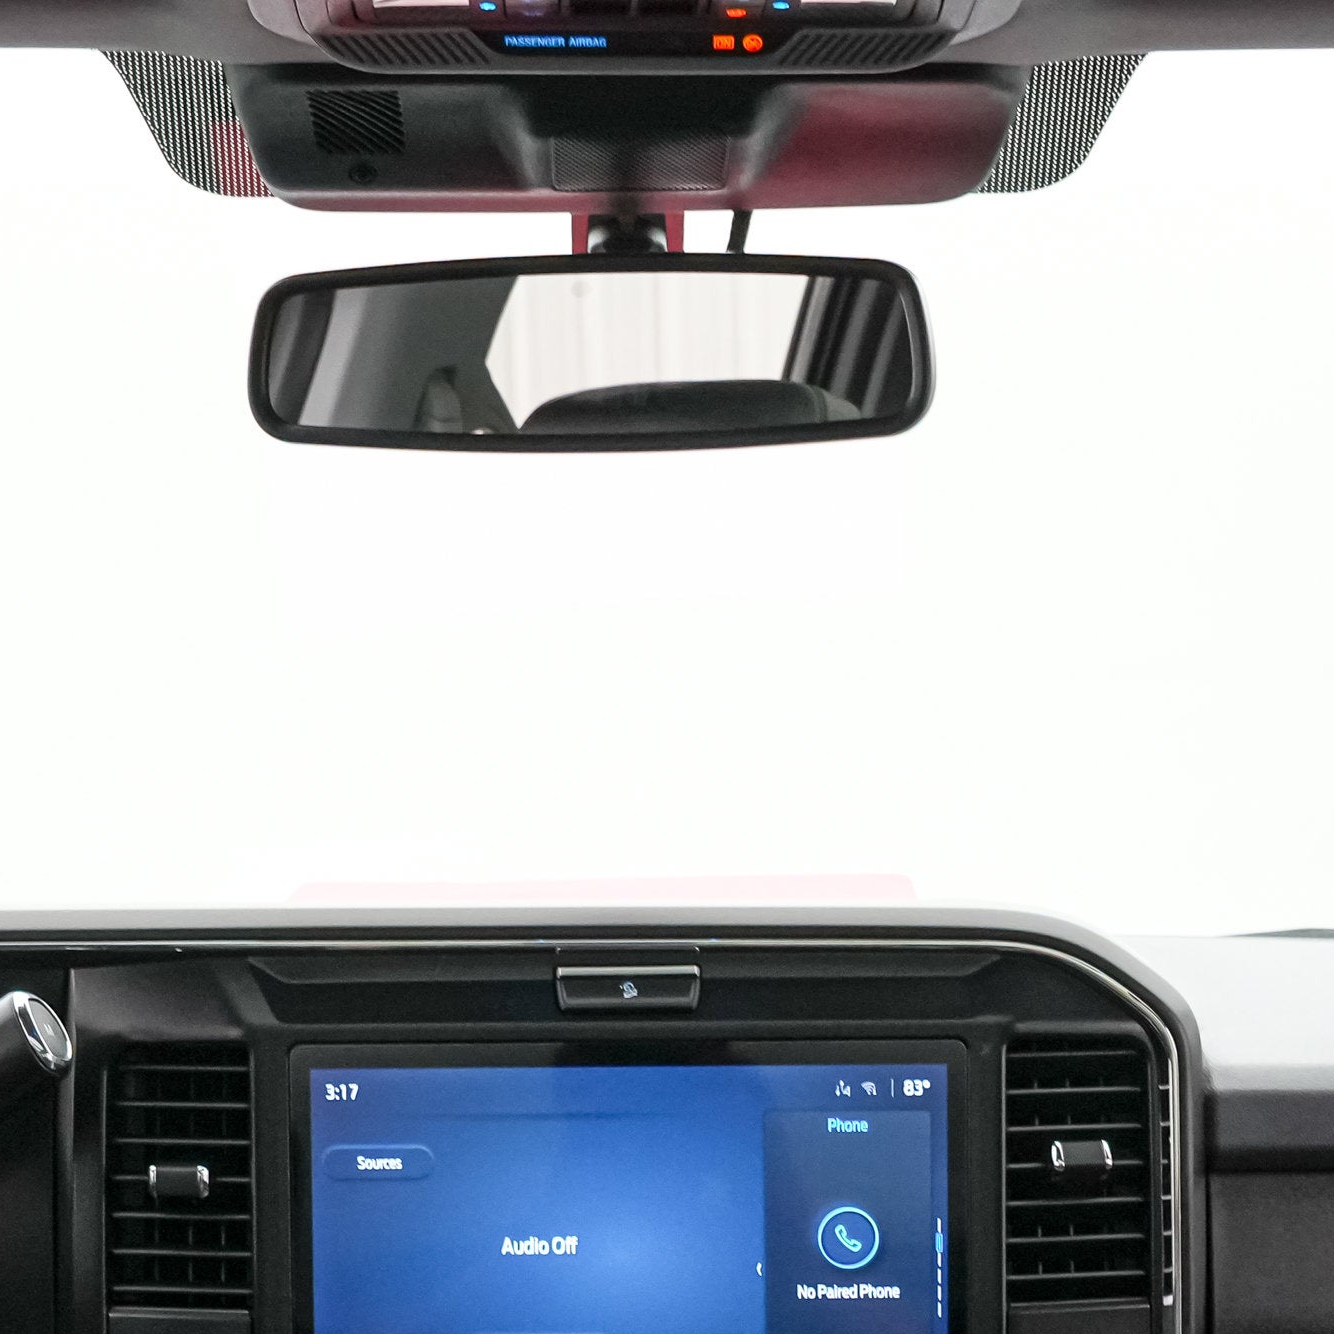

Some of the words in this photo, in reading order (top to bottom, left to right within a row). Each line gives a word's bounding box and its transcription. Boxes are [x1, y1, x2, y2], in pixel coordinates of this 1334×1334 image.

[503, 35, 565, 47] PASSENGER
[568, 35, 607, 47] AIRBAG
[325, 1083, 359, 1101] 3:17
[827, 1117, 868, 1133] Phone
[357, 1156, 402, 1171] Sources
[501, 1236, 547, 1256] Audio
[551, 1236, 578, 1256] Off
[797, 1285, 814, 1299] No
[816, 1284, 858, 1299] Paired
[860, 1284, 900, 1299] Phone
